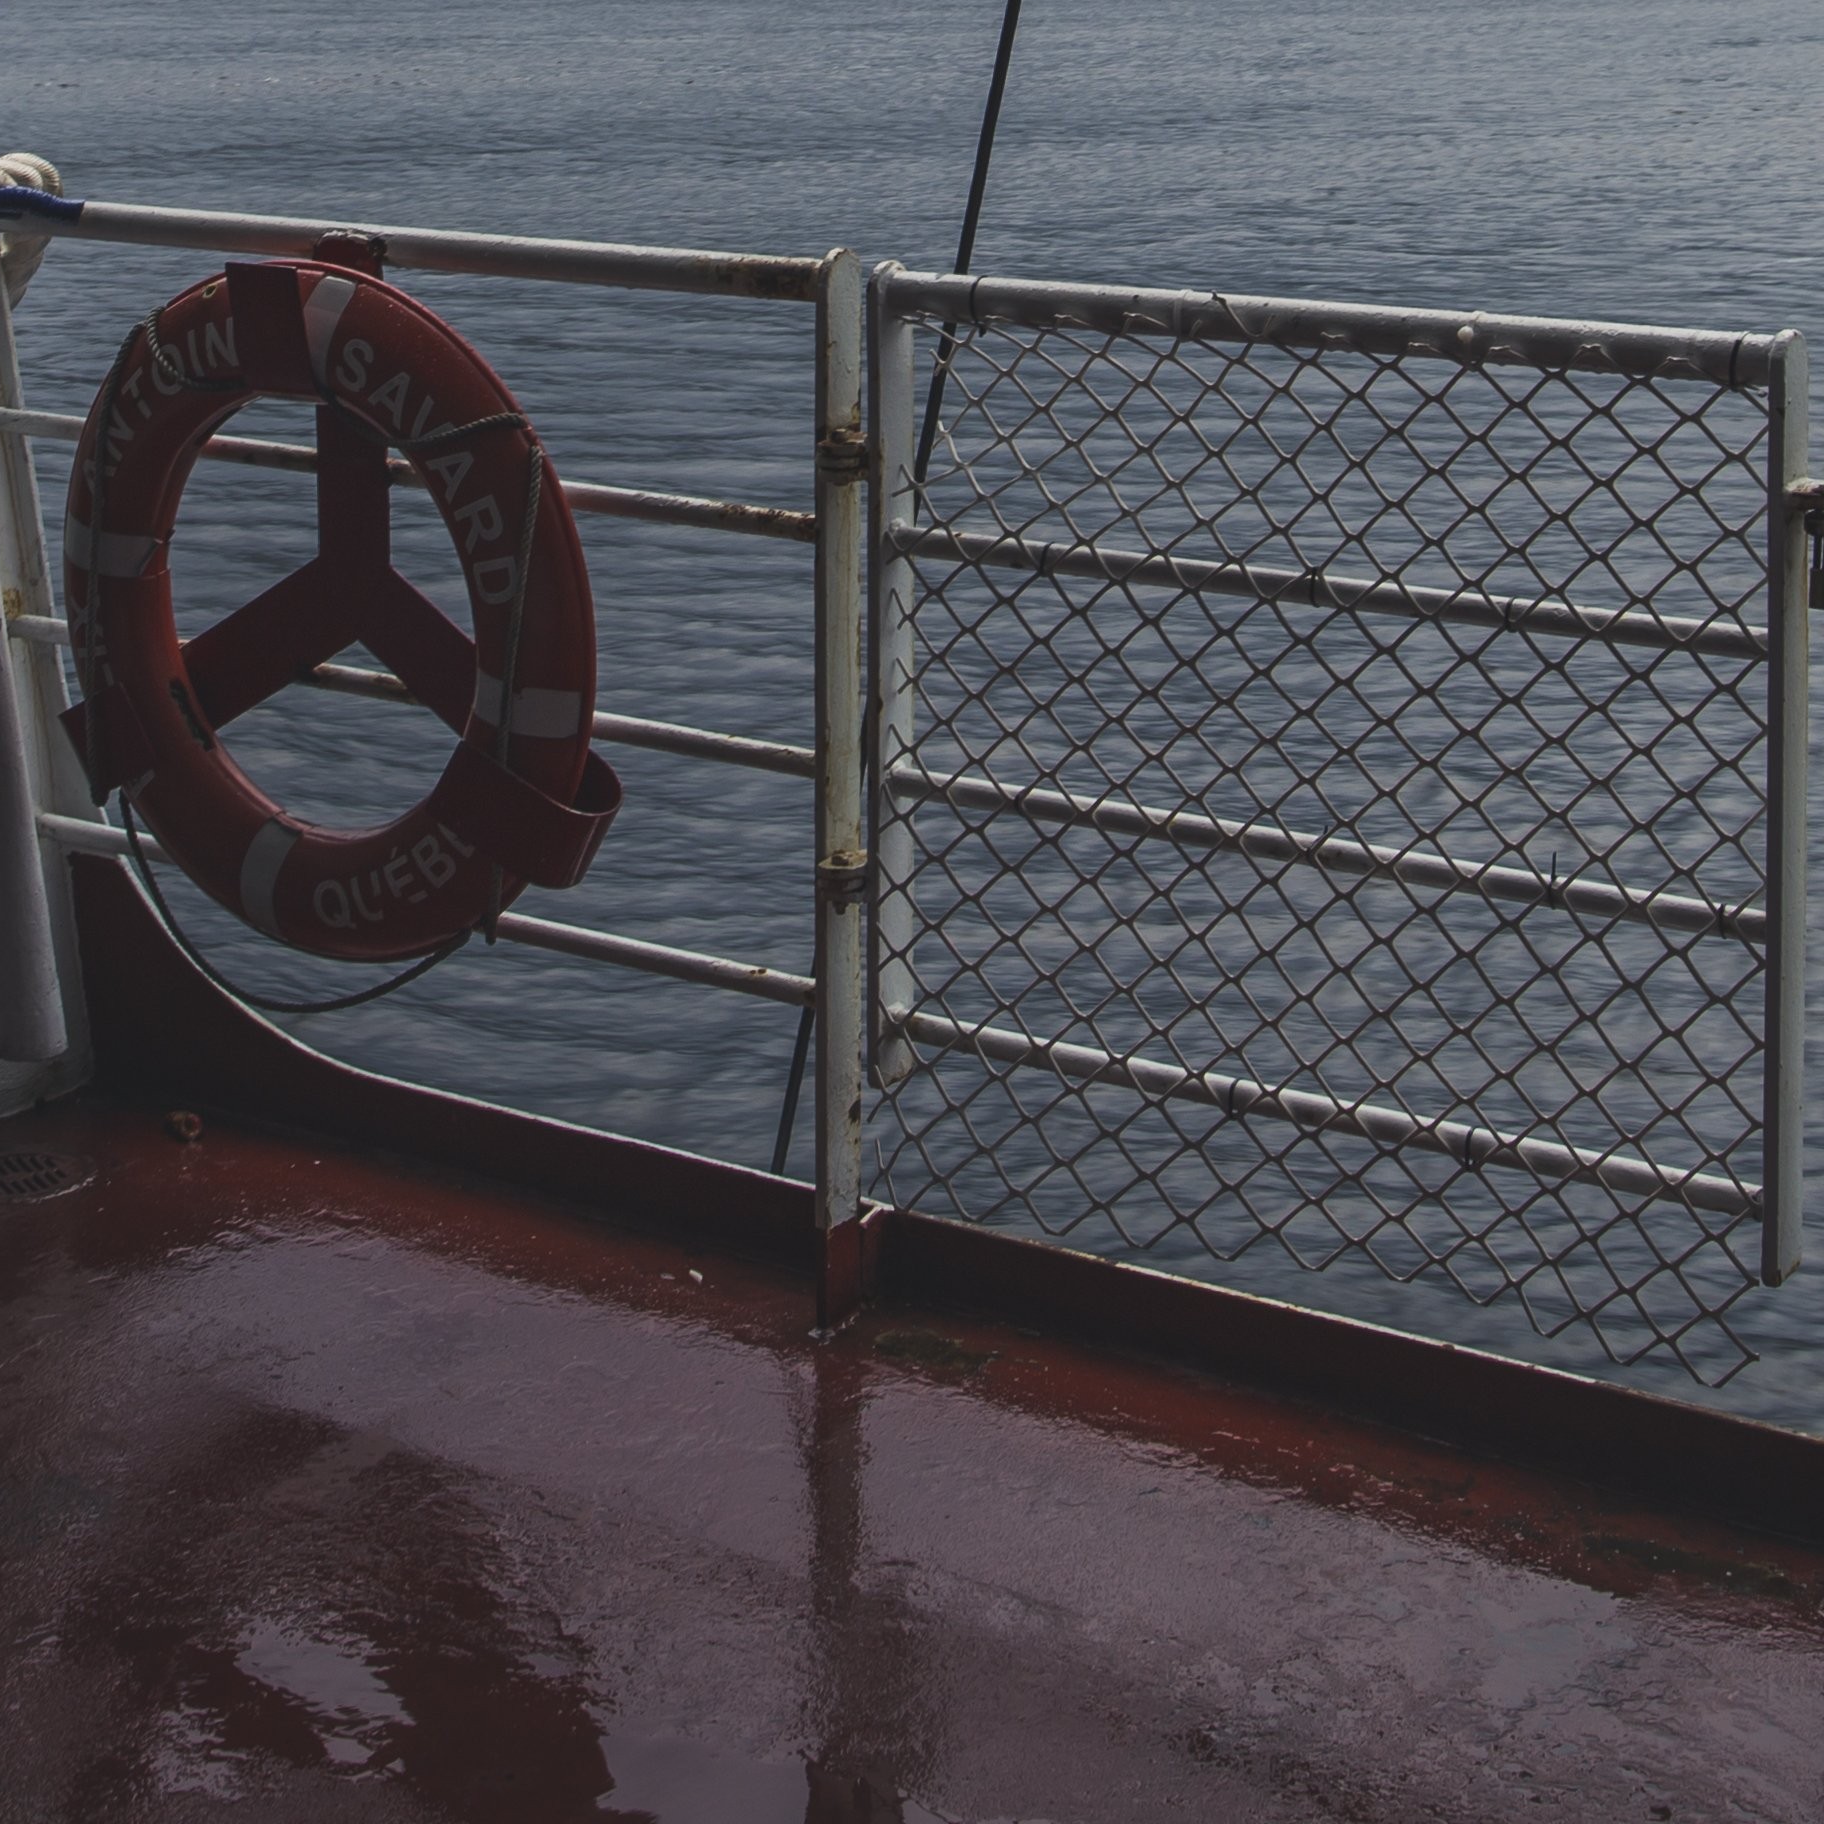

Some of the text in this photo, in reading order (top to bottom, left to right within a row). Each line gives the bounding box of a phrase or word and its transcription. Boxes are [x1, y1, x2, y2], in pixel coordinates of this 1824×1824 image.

[83, 316, 240, 496] ANTOIN
[334, 338, 517, 606] SAVARD
[313, 822, 476, 930] QUÉB
